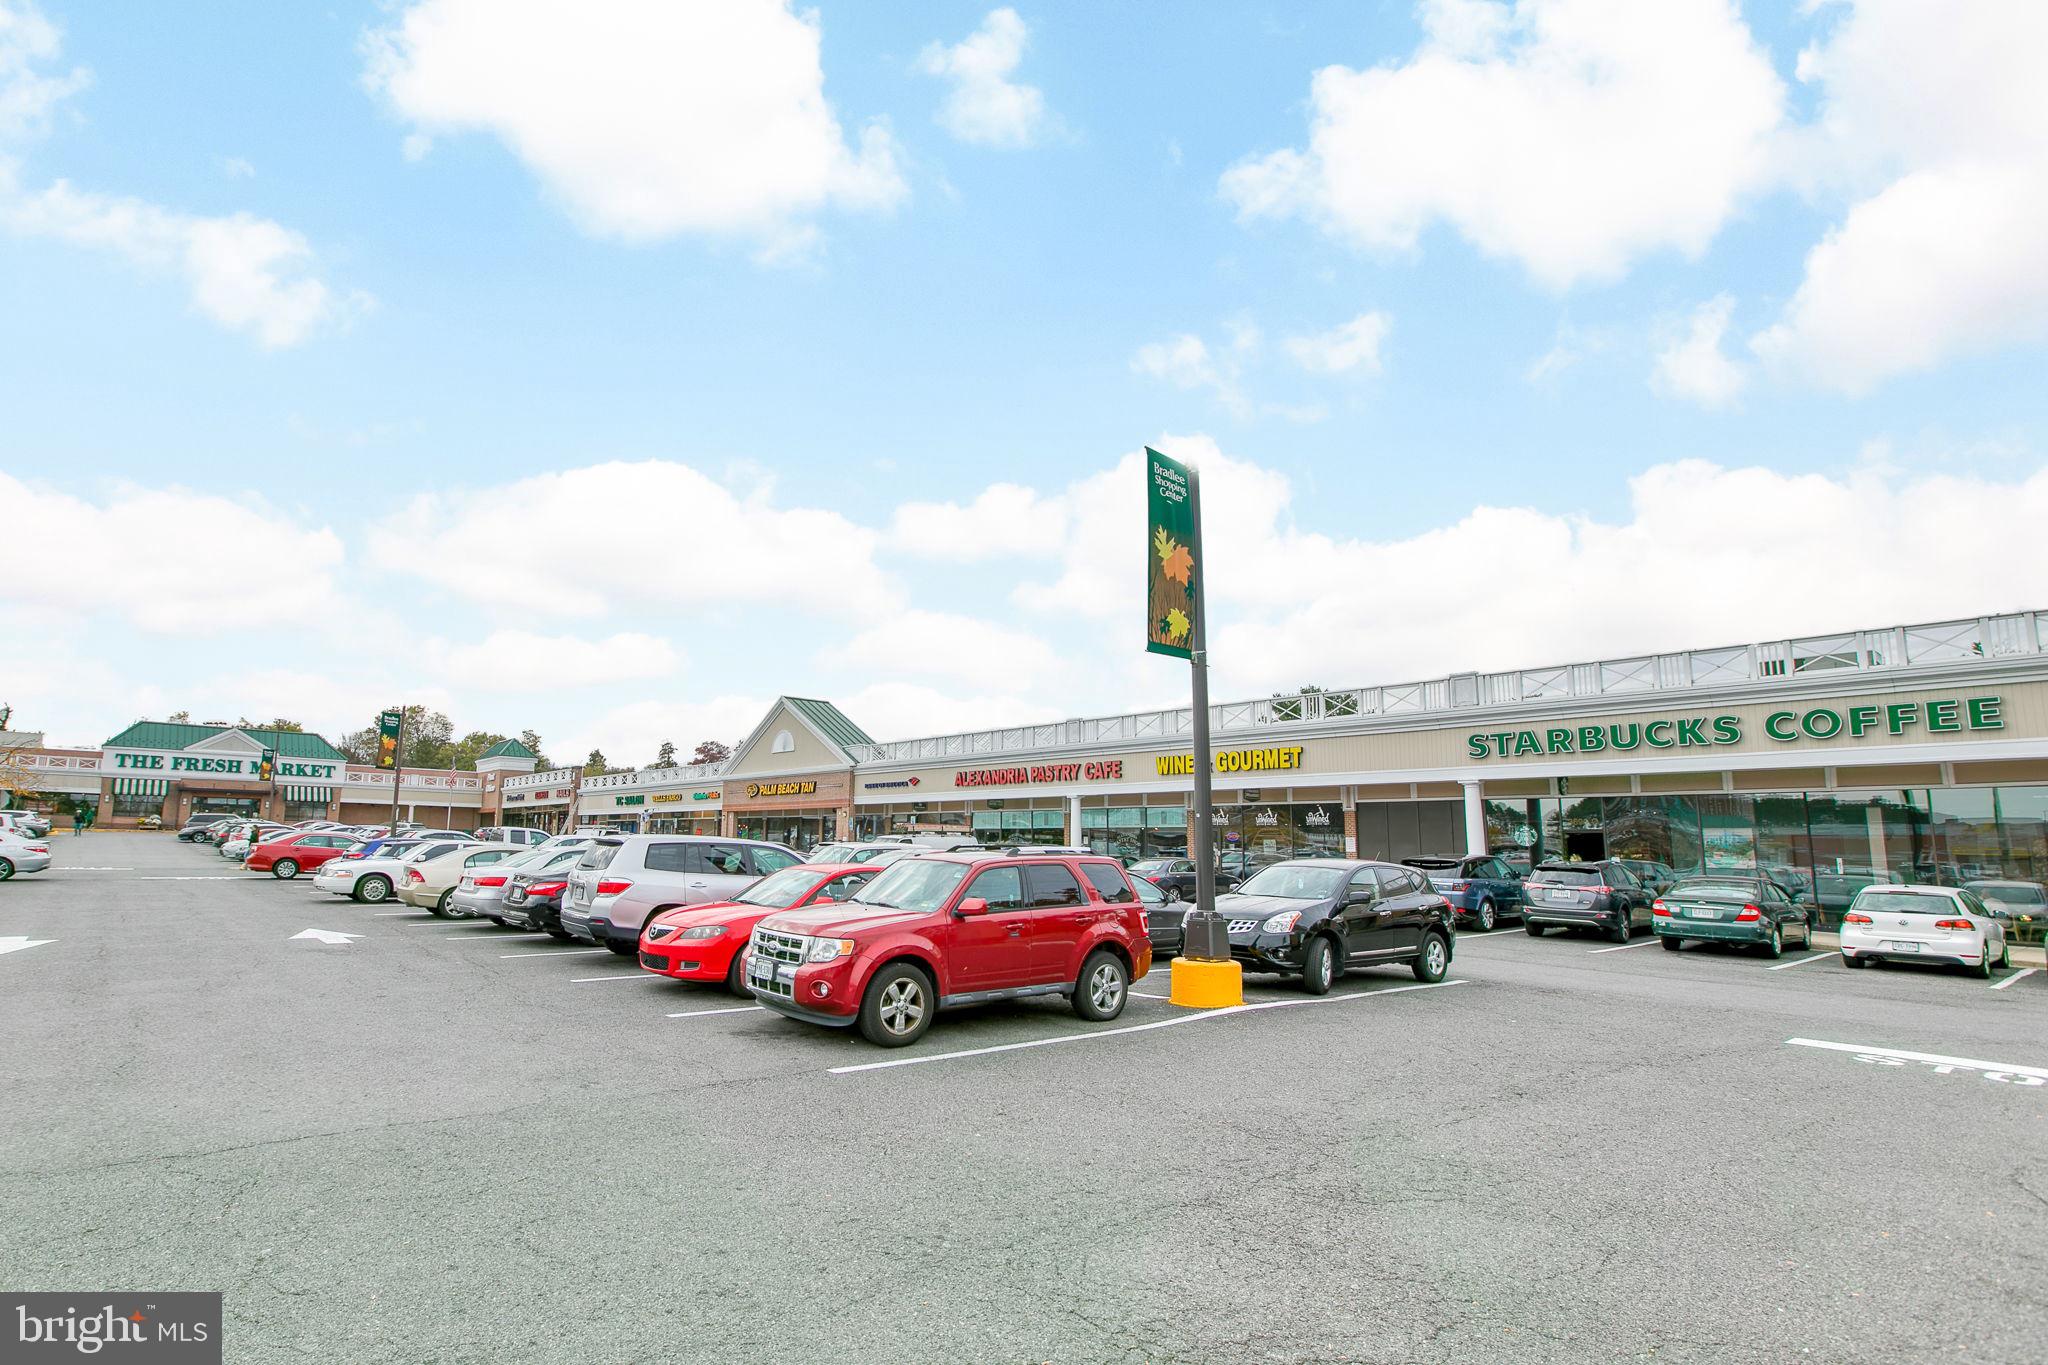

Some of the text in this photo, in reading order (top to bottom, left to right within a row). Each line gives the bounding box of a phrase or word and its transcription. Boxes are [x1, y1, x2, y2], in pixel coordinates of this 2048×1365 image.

[1153, 461, 1185, 485] Bradlee
[1155, 475, 1187, 497] Shopping
[1160, 487, 1183, 503] Center
[1467, 695, 2005, 760] STARBUCKS COFFEE
[115, 753, 164, 770] THE
[171, 756, 243, 774] FRESH
[1155, 745, 1303, 776] WINE GOURMET
[955, 760, 1123, 787] ALEXANDRIA PASTRY CAFE
[760, 781, 817, 796] PALM BEACH TAN
